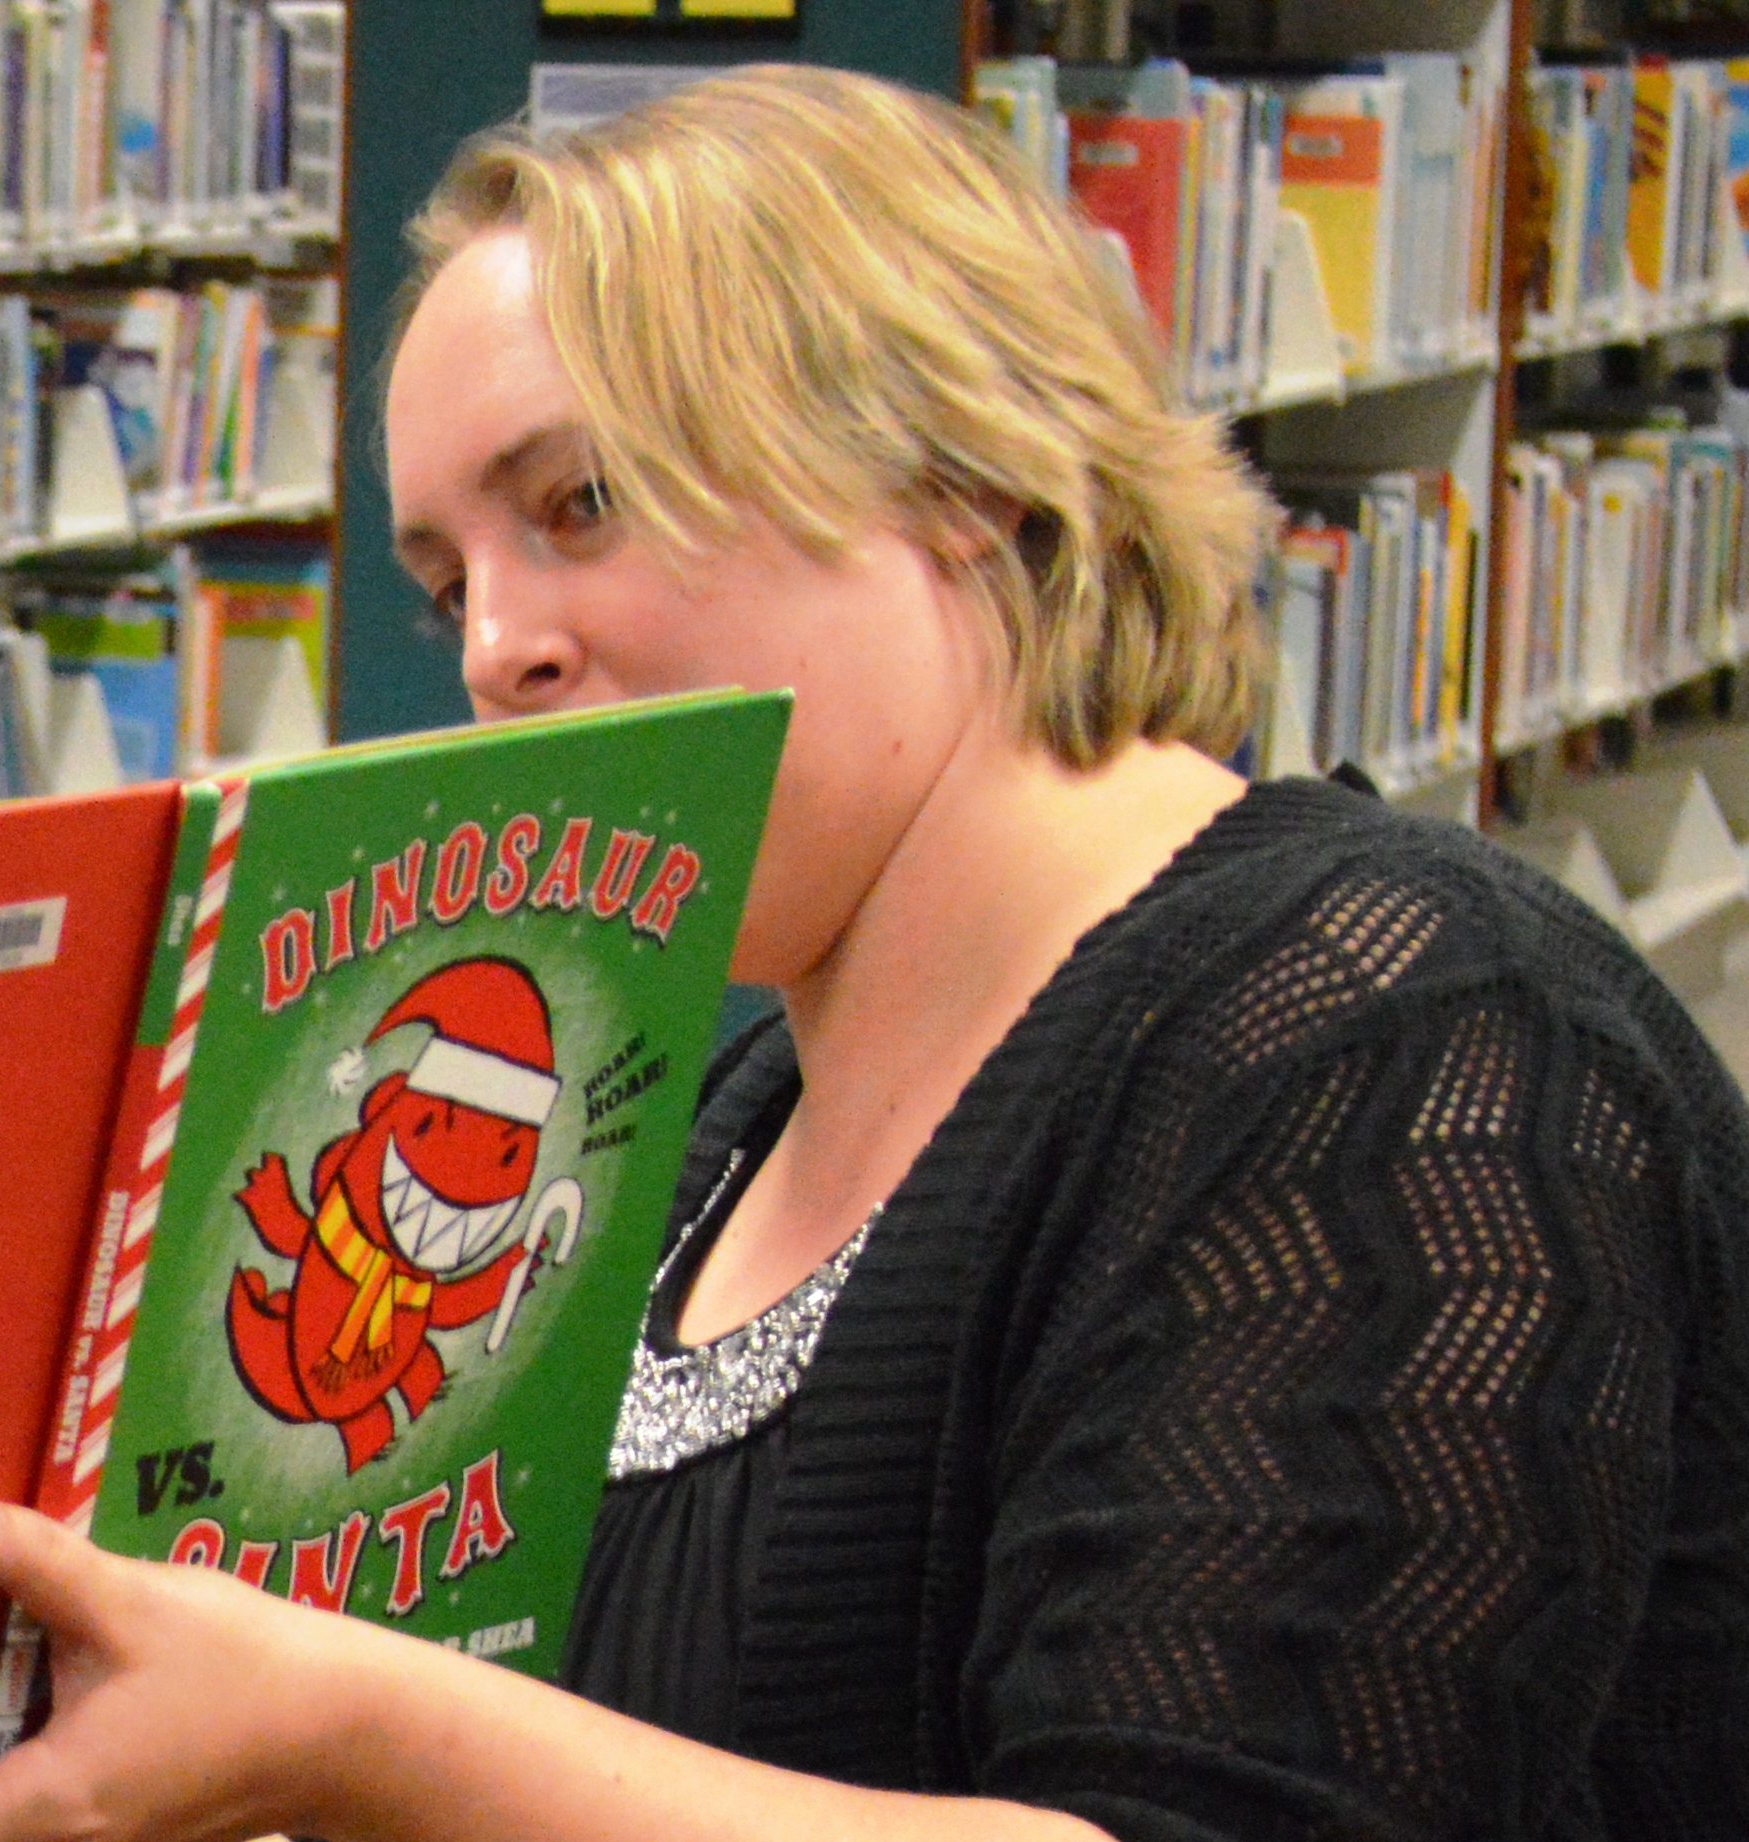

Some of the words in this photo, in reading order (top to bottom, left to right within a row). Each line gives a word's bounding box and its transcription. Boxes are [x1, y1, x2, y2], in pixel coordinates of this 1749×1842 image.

[258, 813, 701, 1014] DINOSAUR
[583, 1032, 646, 1098] ROAR!
[586, 1054, 669, 1125] ROAR!
[135, 1440, 225, 1516] VS.
